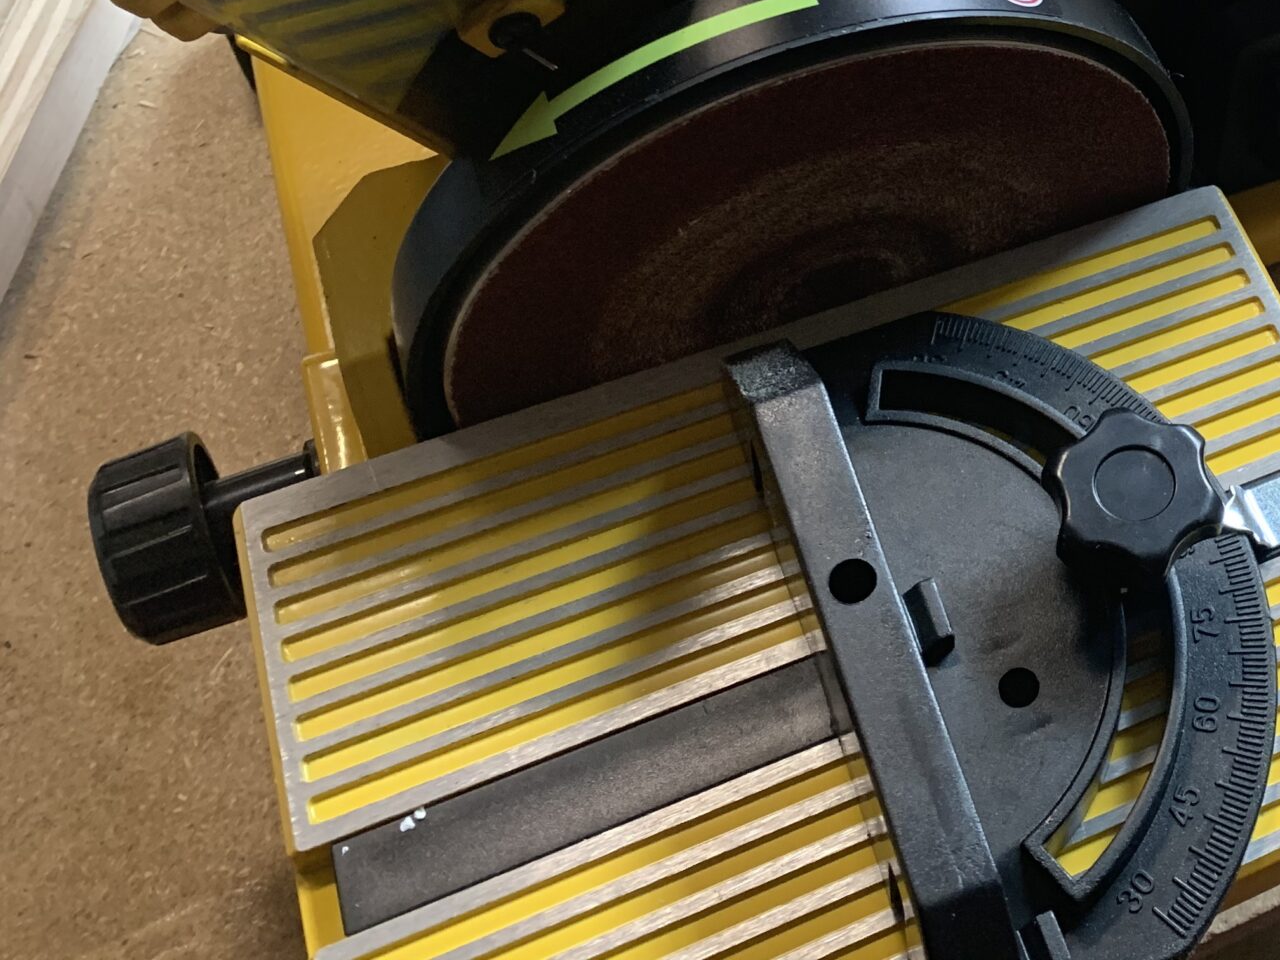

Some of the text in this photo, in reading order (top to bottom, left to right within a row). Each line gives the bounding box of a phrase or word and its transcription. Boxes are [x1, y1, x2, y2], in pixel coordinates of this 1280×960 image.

[1190, 606, 1217, 644] 75
[1193, 696, 1221, 734] 60
[1169, 786, 1200, 828] 45
[1115, 869, 1155, 914] 30
